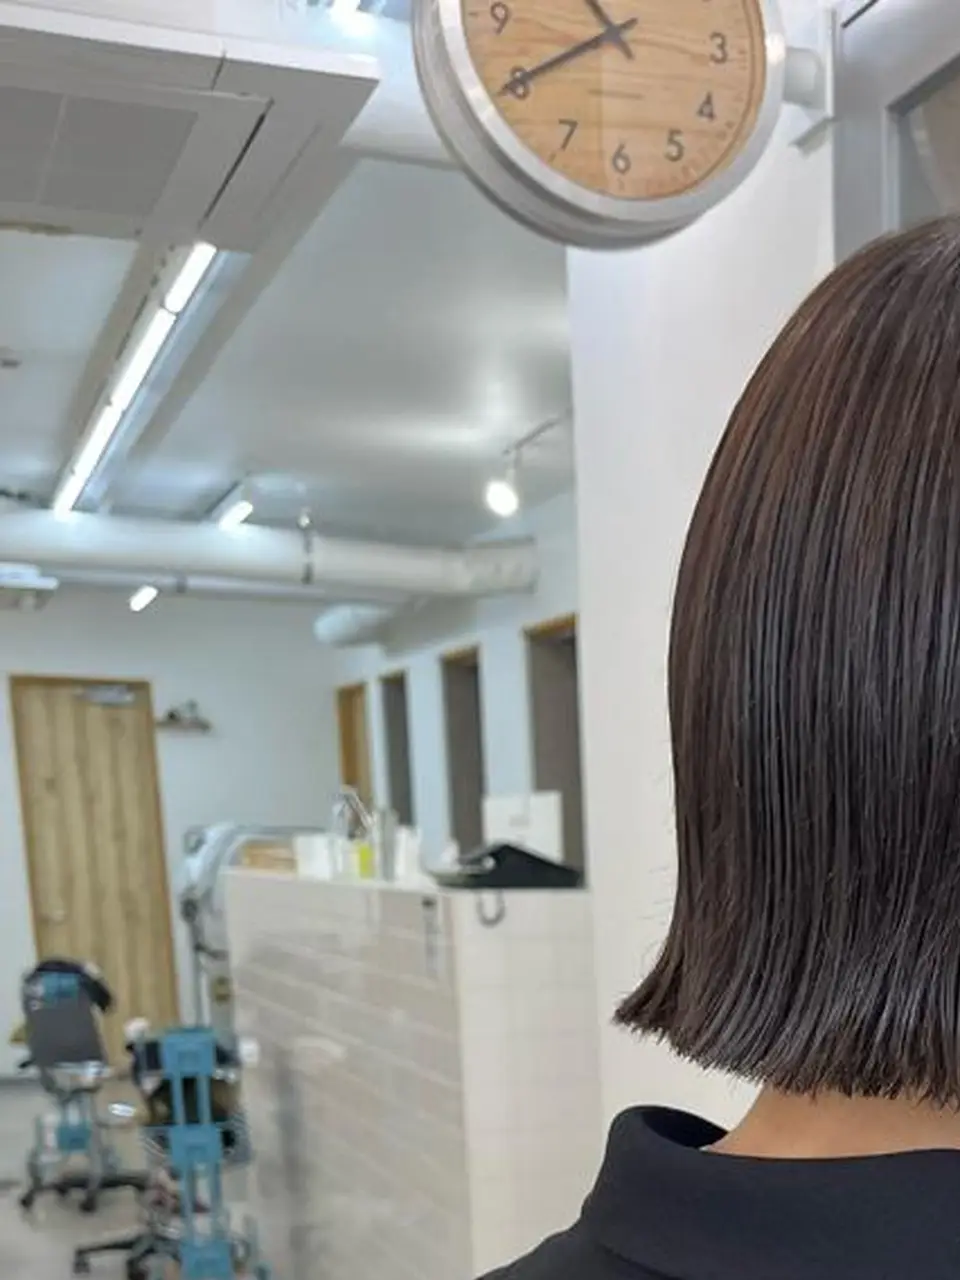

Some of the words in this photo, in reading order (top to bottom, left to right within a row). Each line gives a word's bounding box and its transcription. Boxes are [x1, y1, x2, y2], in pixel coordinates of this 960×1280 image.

[490, 2, 509, 33] 9
[709, 32, 727, 64] 3
[697, 92, 715, 120] 4
[558, 119, 578, 151] 7
[663, 129, 684, 162] 5
[611, 143, 631, 174] 6
